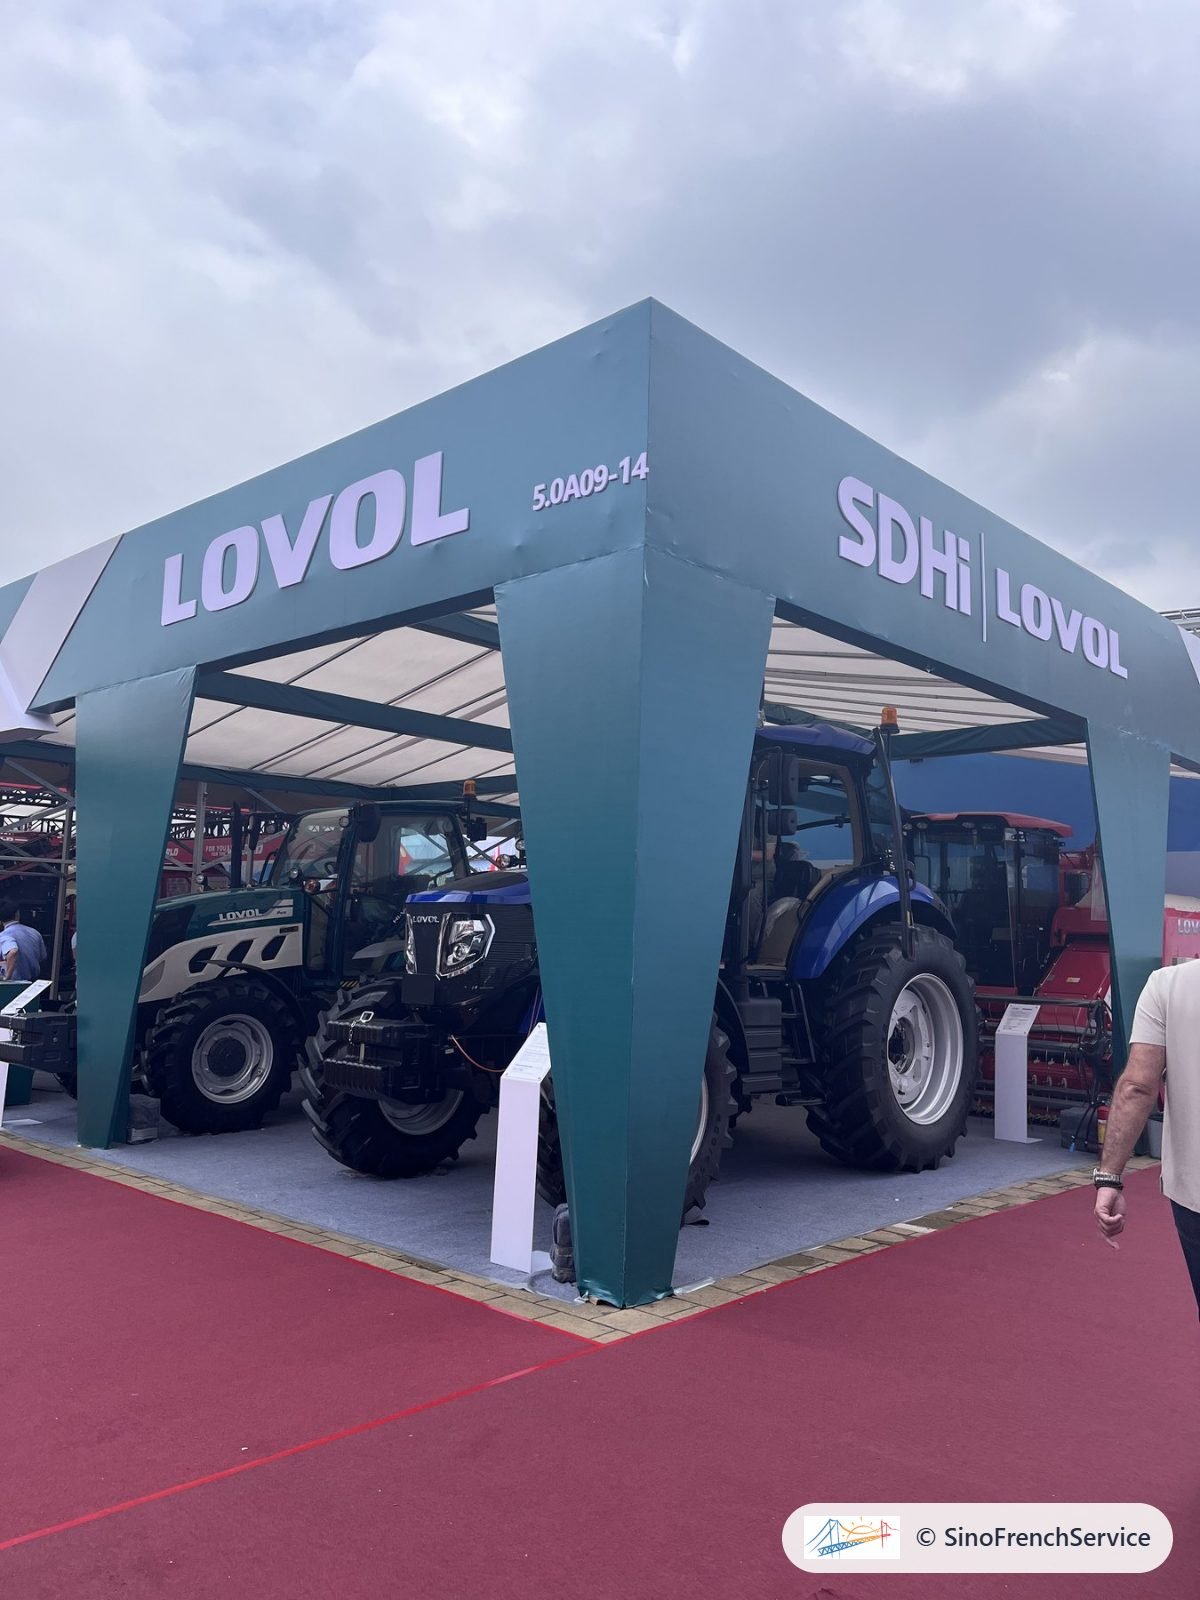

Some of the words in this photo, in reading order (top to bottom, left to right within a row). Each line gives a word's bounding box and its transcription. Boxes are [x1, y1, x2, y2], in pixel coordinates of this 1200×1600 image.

[532, 451, 649, 512] 5.0A09-14
[161, 451, 470, 626] LOVOL
[838, 476, 971, 616] SDHi
[995, 567, 1128, 679] LOVOL
[219, 908, 264, 921] LOVOL
[412, 915, 439, 923] LOVOL
[1178, 919, 1200, 933] LOV
